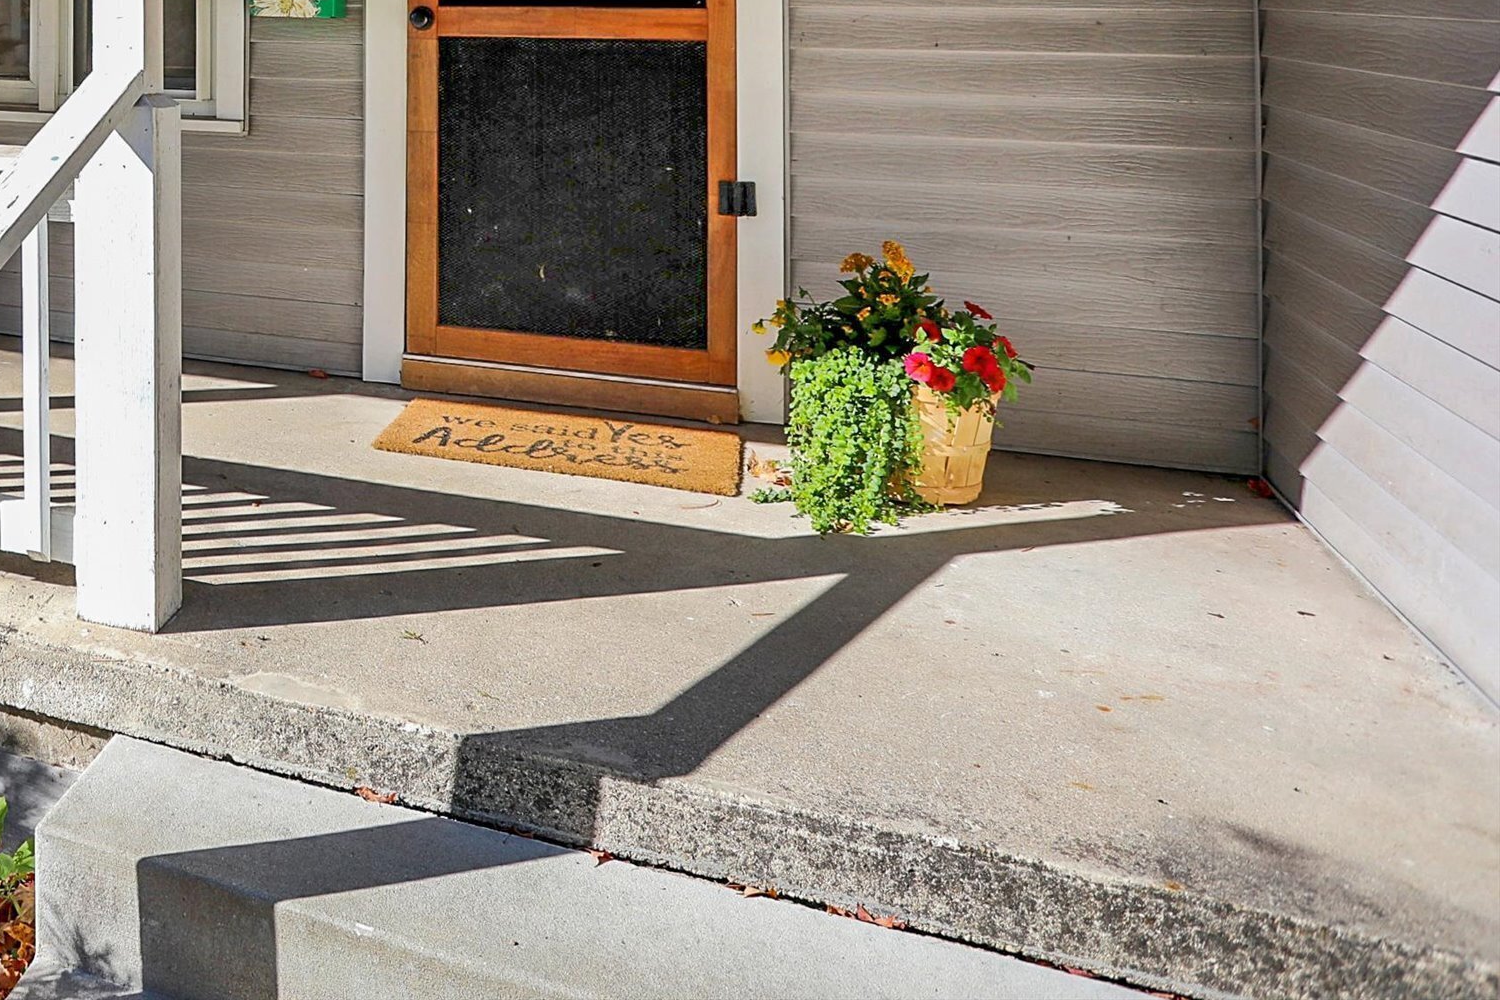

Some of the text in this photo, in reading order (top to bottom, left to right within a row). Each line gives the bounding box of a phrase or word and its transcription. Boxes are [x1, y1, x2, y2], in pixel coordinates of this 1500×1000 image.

[412, 426, 690, 474] Address
[510, 423, 598, 440] said
[603, 420, 692, 450] Yes
